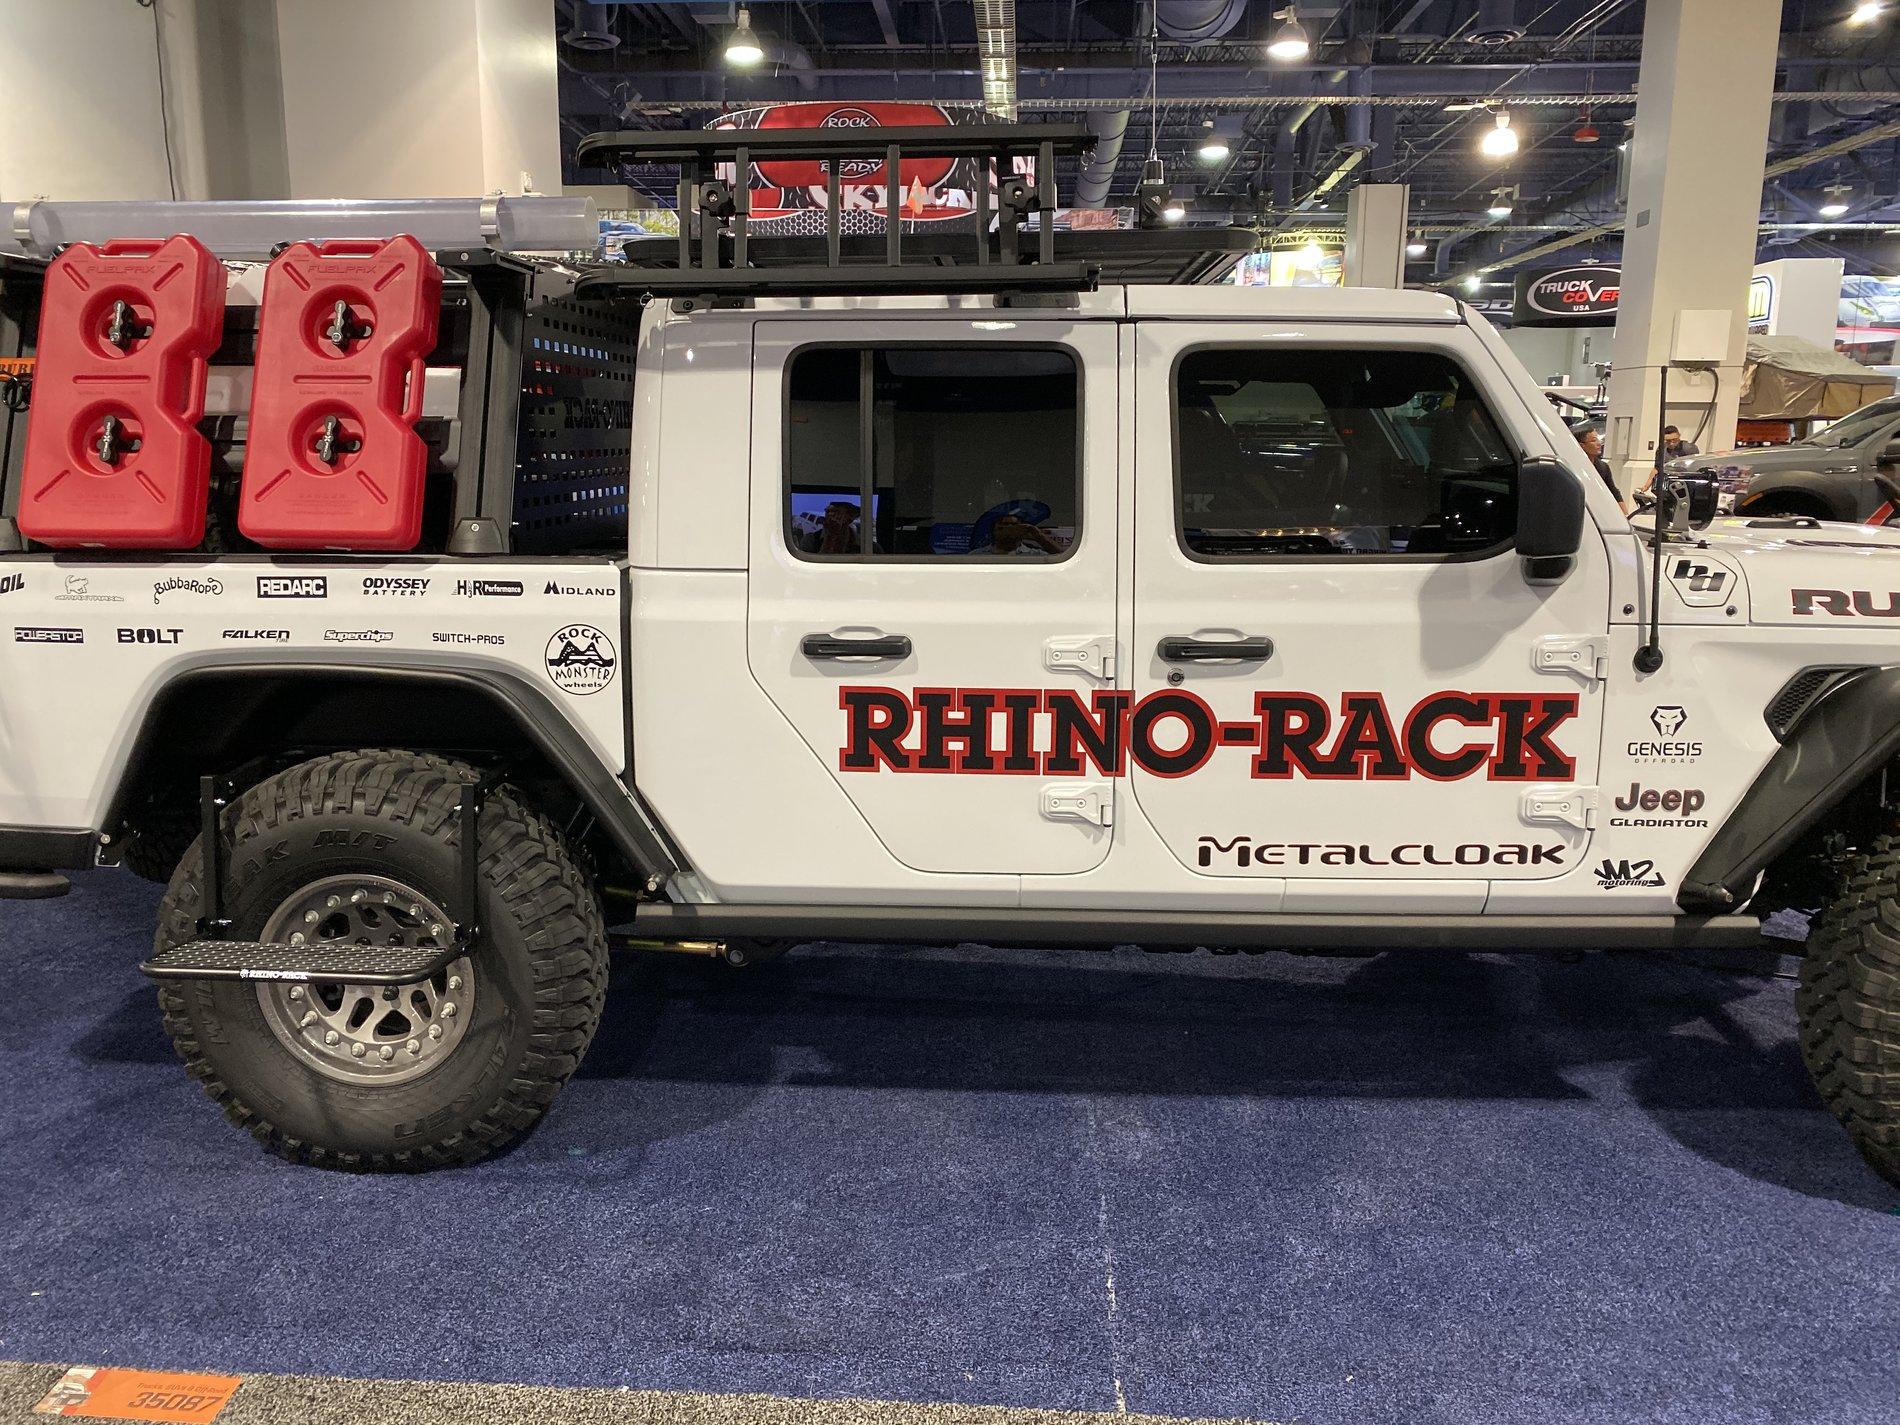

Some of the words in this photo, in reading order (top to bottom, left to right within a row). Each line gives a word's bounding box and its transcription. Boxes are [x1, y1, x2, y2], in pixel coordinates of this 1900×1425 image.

[827, 117, 871, 128] ROCK
[1540, 280, 1594, 294] TRUCK
[1573, 304, 1590, 312] USA
[260, 579, 325, 596] REDARC
[363, 577, 431, 589] ODYSSEY
[484, 584, 521, 594] Performance
[544, 580, 616, 596] MIDLAND
[117, 628, 184, 644] BOLT
[222, 630, 290, 639] FALKEN
[324, 629, 393, 642] Superchips
[432, 632, 505, 645] SWITCH-PROS
[558, 628, 602, 645] ROCK
[555, 666, 610, 681] MONSTER
[839, 686, 1579, 782] RHINO-RACK
[1627, 742, 1703, 756] GENESIS
[1615, 782, 1705, 817] Jeep
[1610, 817, 1708, 828] GLADIATOR
[128, 1392, 223, 1412] 35087
